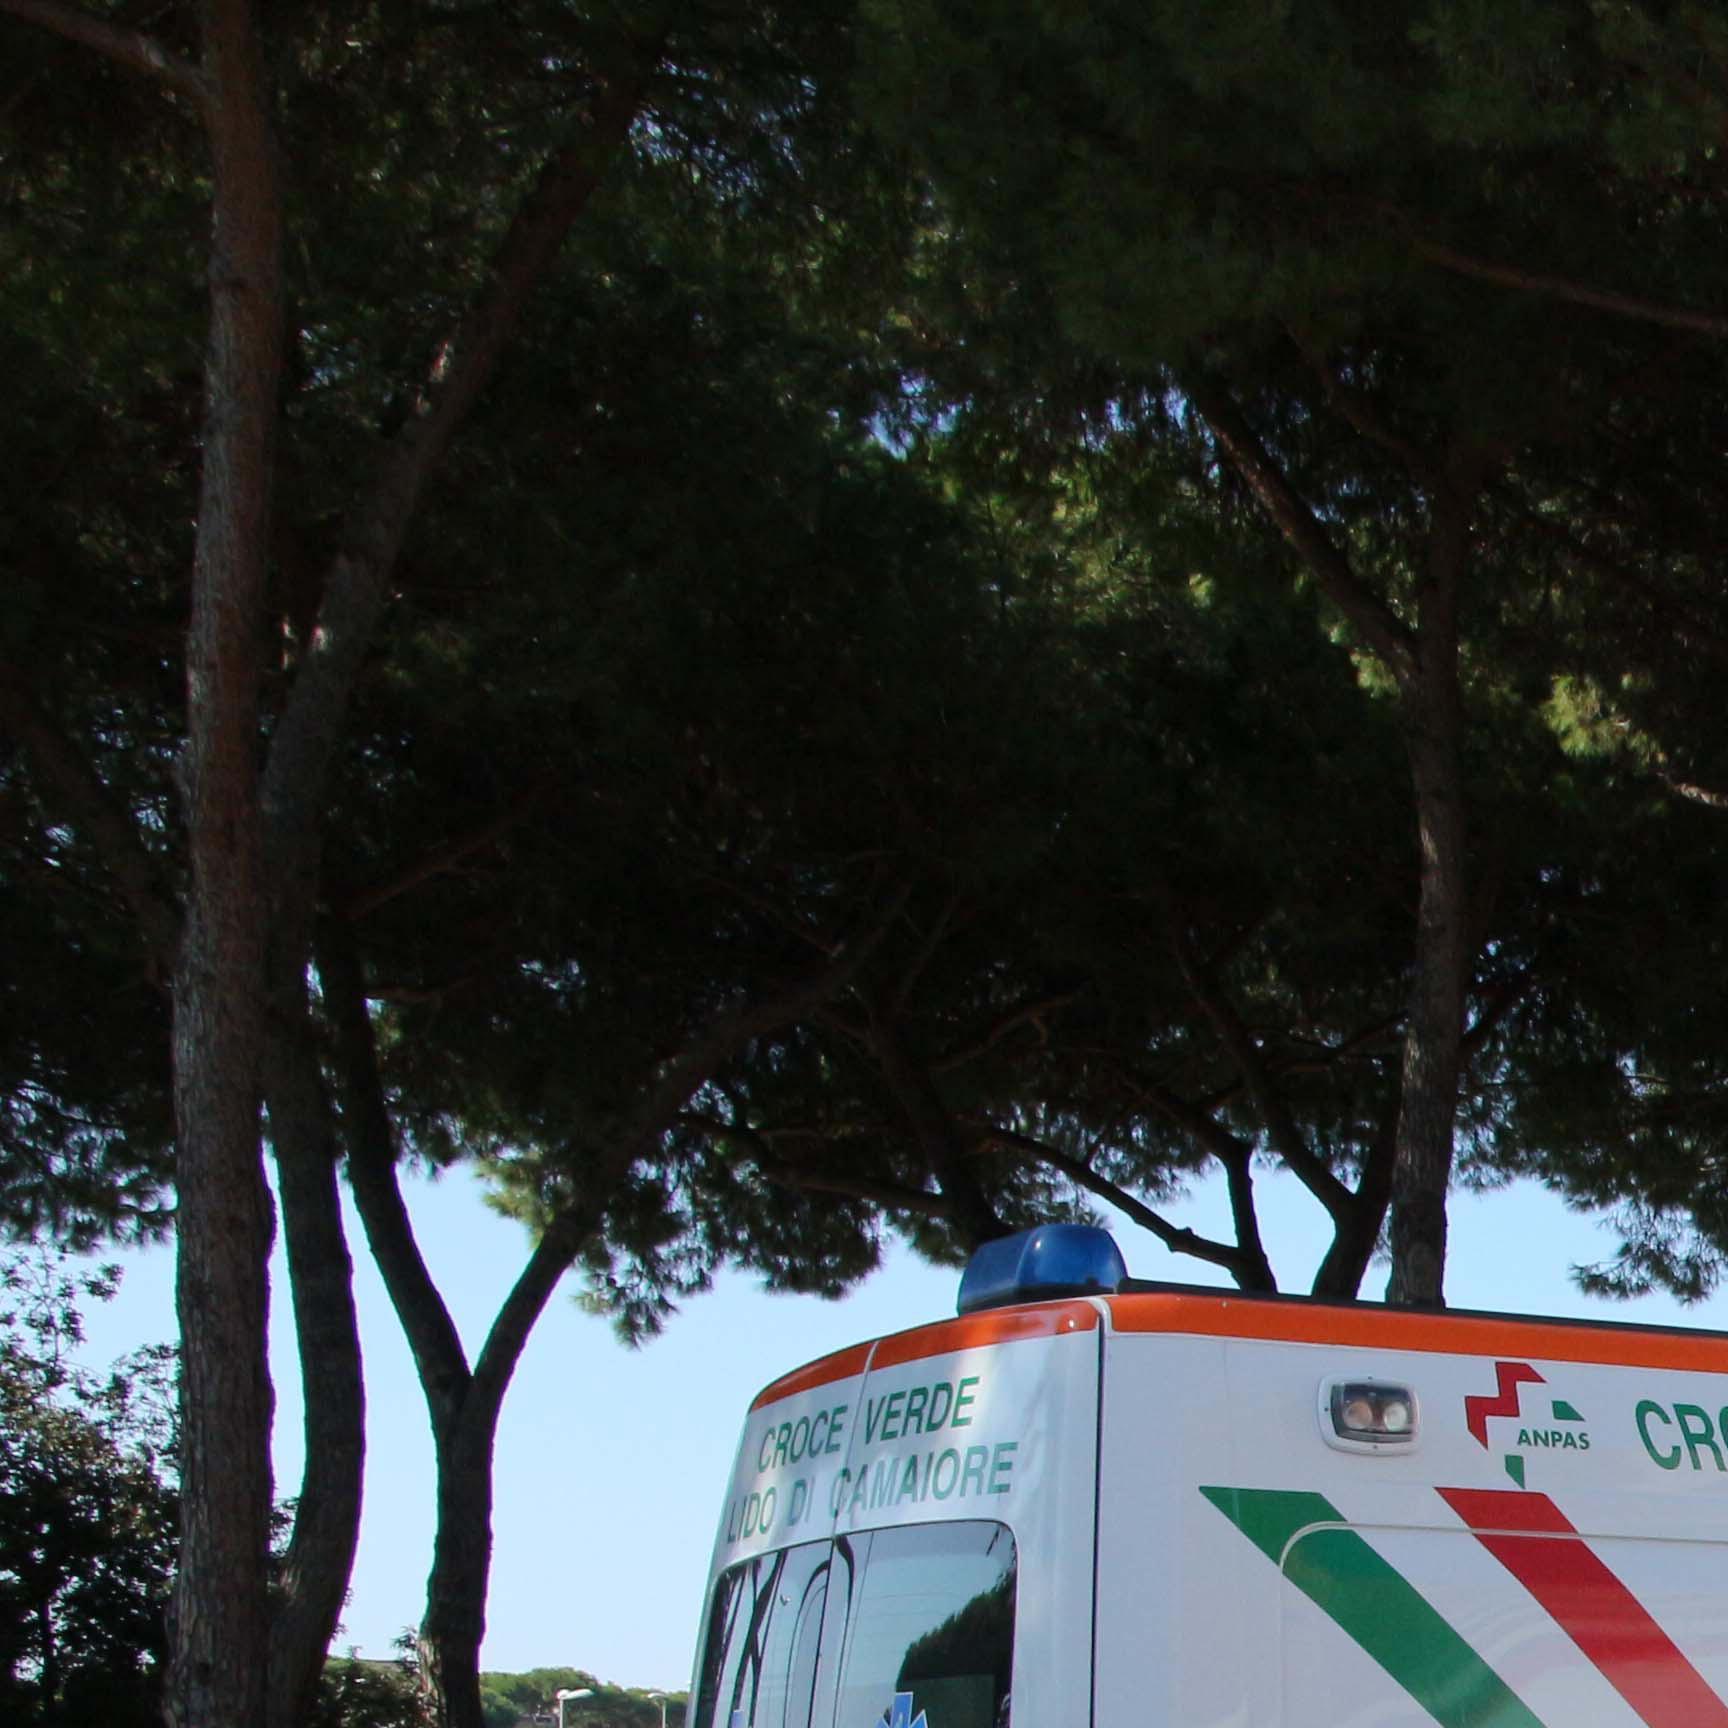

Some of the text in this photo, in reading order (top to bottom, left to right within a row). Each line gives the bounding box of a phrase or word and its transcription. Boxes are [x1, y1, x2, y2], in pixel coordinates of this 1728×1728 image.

[758, 1376, 980, 1473] CROCE VERDE
[1517, 1428, 1590, 1450] ANPAS
[727, 1441, 1019, 1544] LIDO DI CAMAIORE
